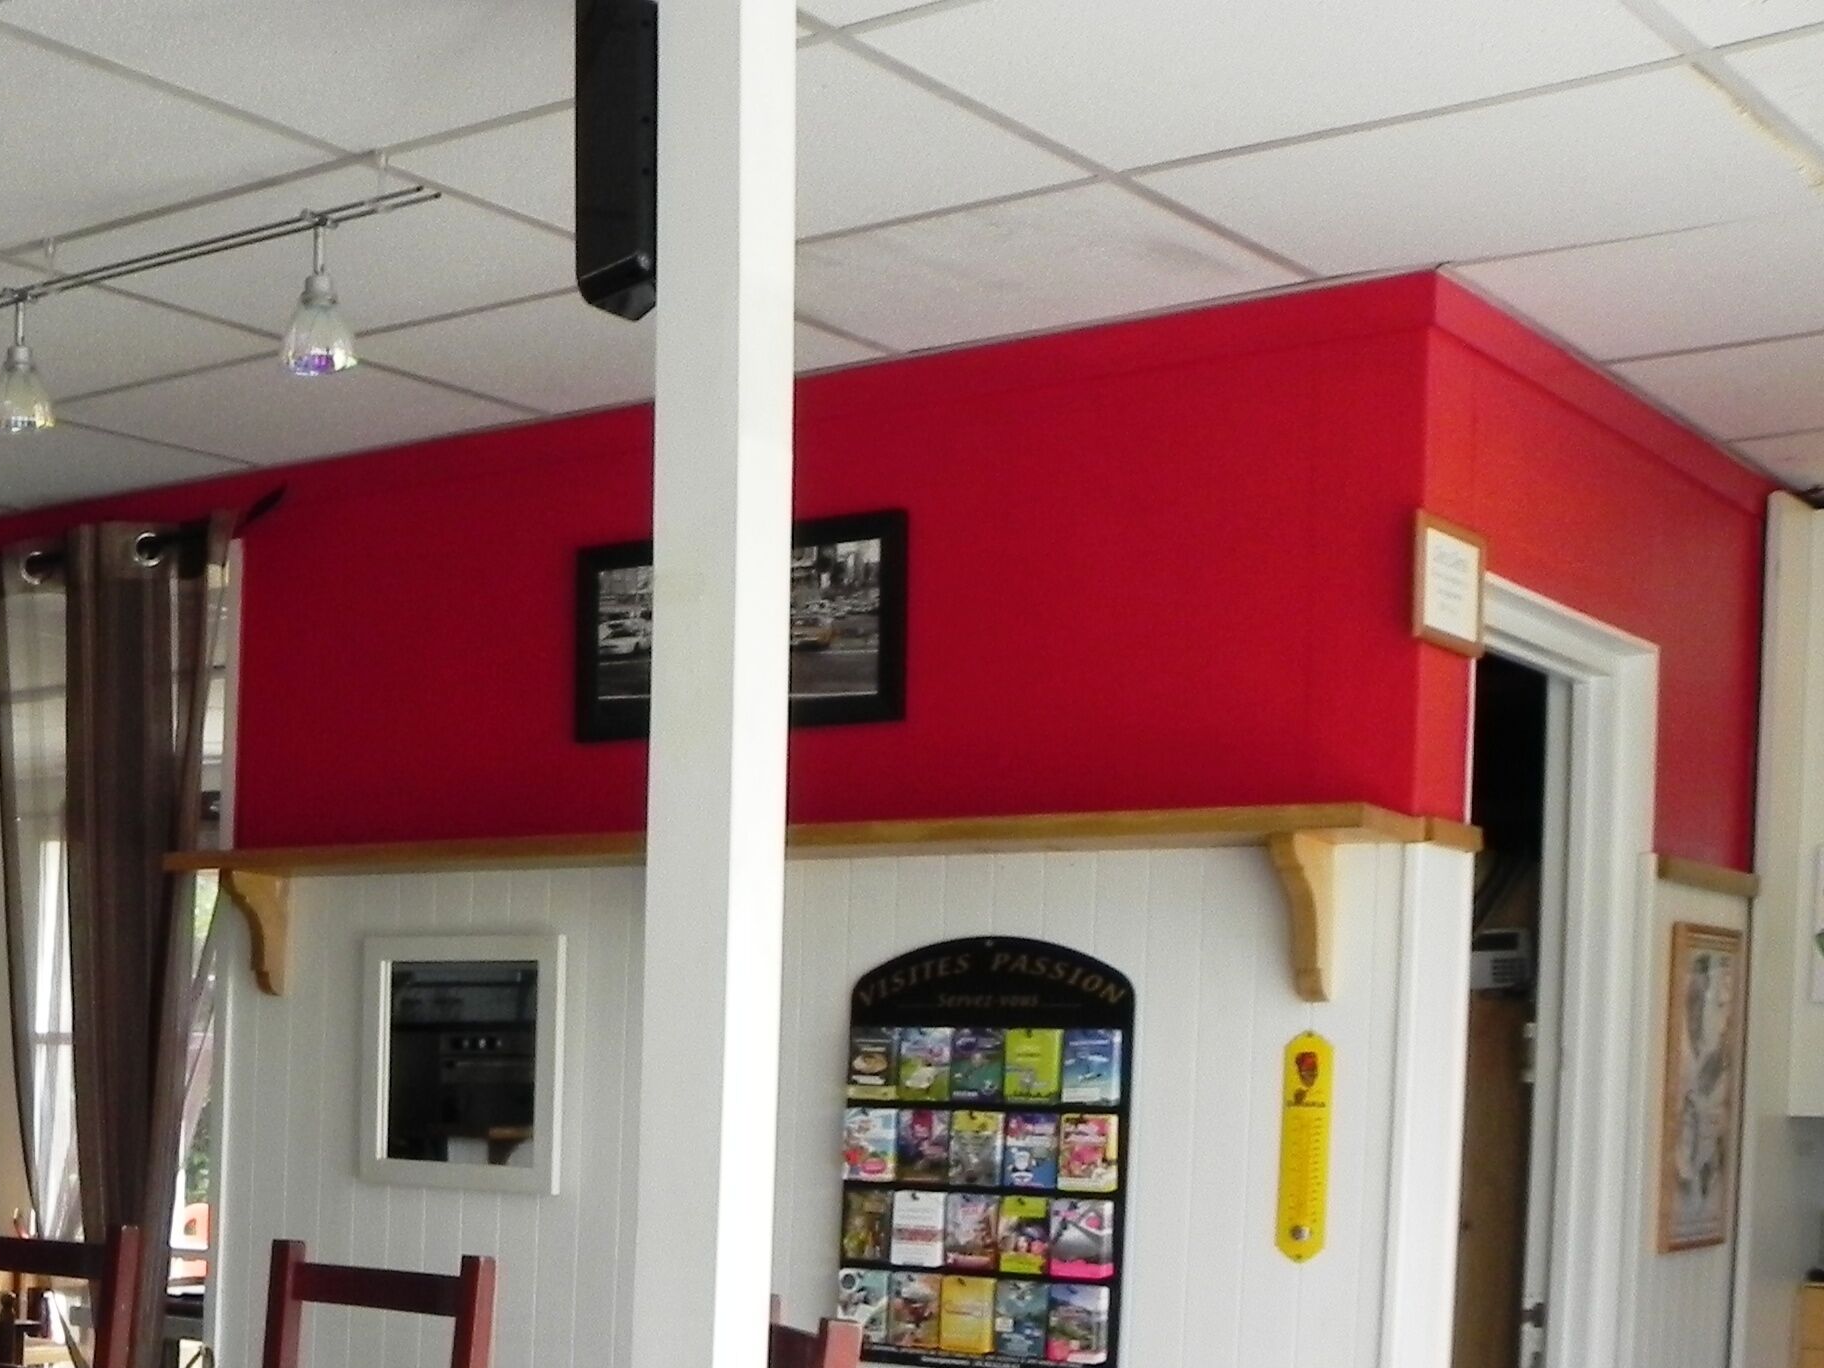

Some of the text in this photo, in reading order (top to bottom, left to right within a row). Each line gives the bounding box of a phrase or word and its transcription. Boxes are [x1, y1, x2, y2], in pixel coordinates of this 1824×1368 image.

[857, 952, 1127, 1007] VISITES PASSION
[936, 993, 1040, 1009] Servez-vous
